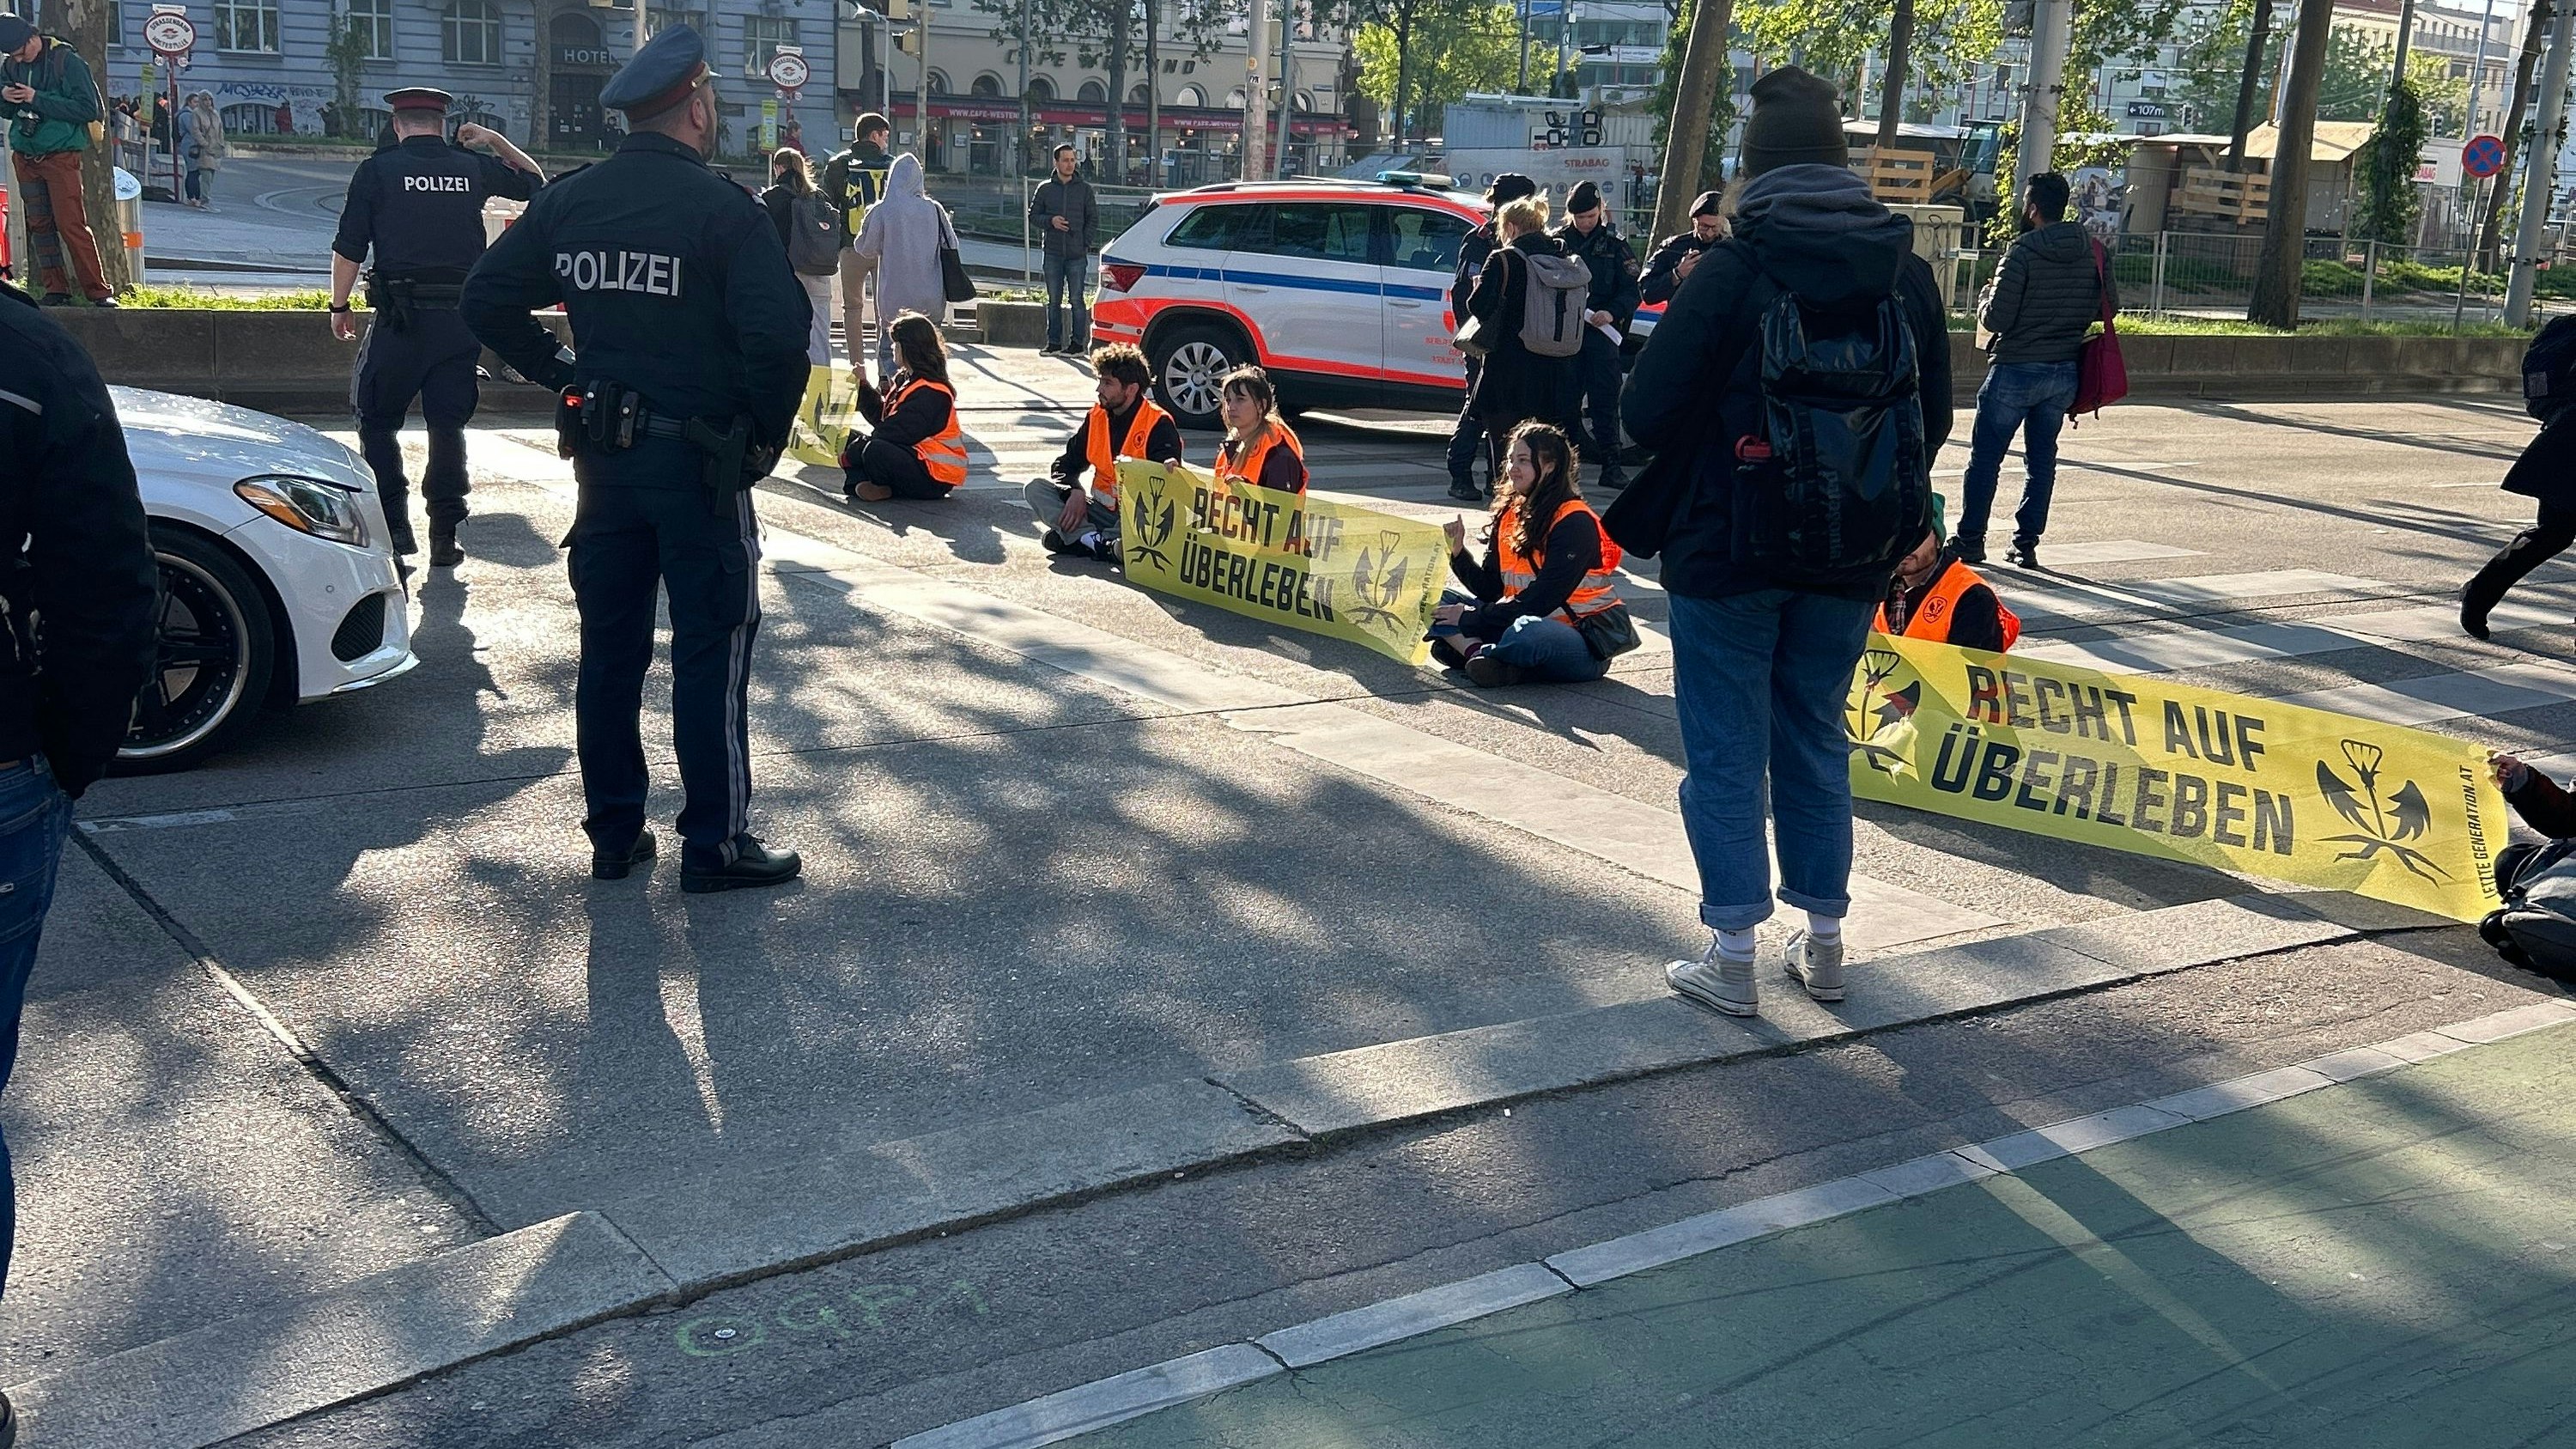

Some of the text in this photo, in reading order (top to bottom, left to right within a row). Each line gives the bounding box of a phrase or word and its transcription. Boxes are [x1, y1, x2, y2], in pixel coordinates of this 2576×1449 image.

[564, 48, 616, 64] HOTEL
[2138, 105, 2164, 117] 107m
[404, 176, 470, 192] POLIZEI
[1564, 158, 1610, 168] STRABAG
[555, 251, 681, 296] POLIZEI
[1191, 487, 1280, 548] RECHT
[1284, 508, 1345, 563] AUF
[1180, 533, 1335, 623] ÜBERLEBEN
[1966, 666, 2266, 772] RECHT AUF
[1931, 723, 2294, 857] ÜBERLEBEN
[2459, 764, 2488, 860] GENERATION.AT
